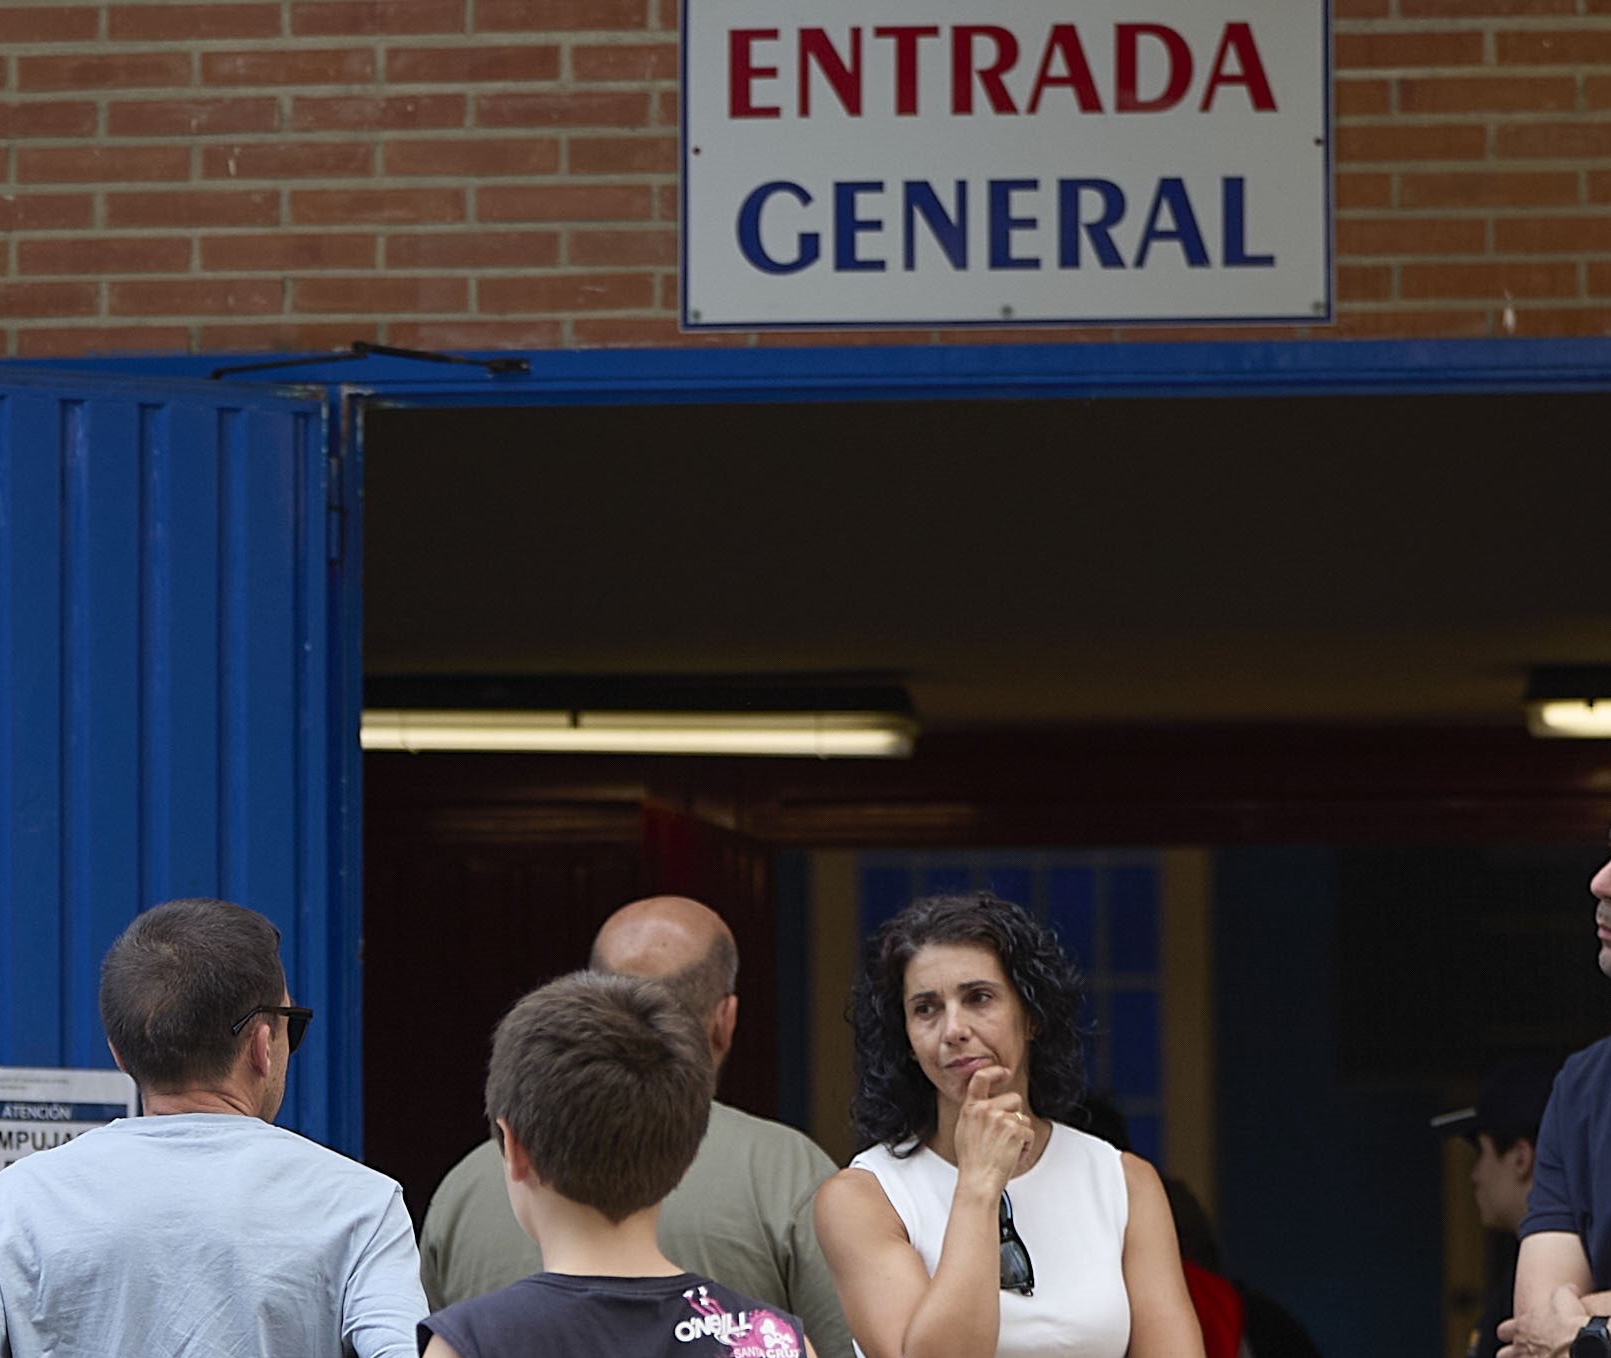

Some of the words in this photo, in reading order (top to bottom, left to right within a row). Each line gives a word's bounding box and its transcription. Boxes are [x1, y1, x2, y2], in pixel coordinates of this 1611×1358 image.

[728, 21, 1278, 119] ENTRADA
[735, 176, 1277, 276] GENERAL
[2, 1103, 72, 1121] ATENCIÓN
[674, 1311, 753, 1343] O'NEILL
[733, 1346, 766, 1358] SANTA
